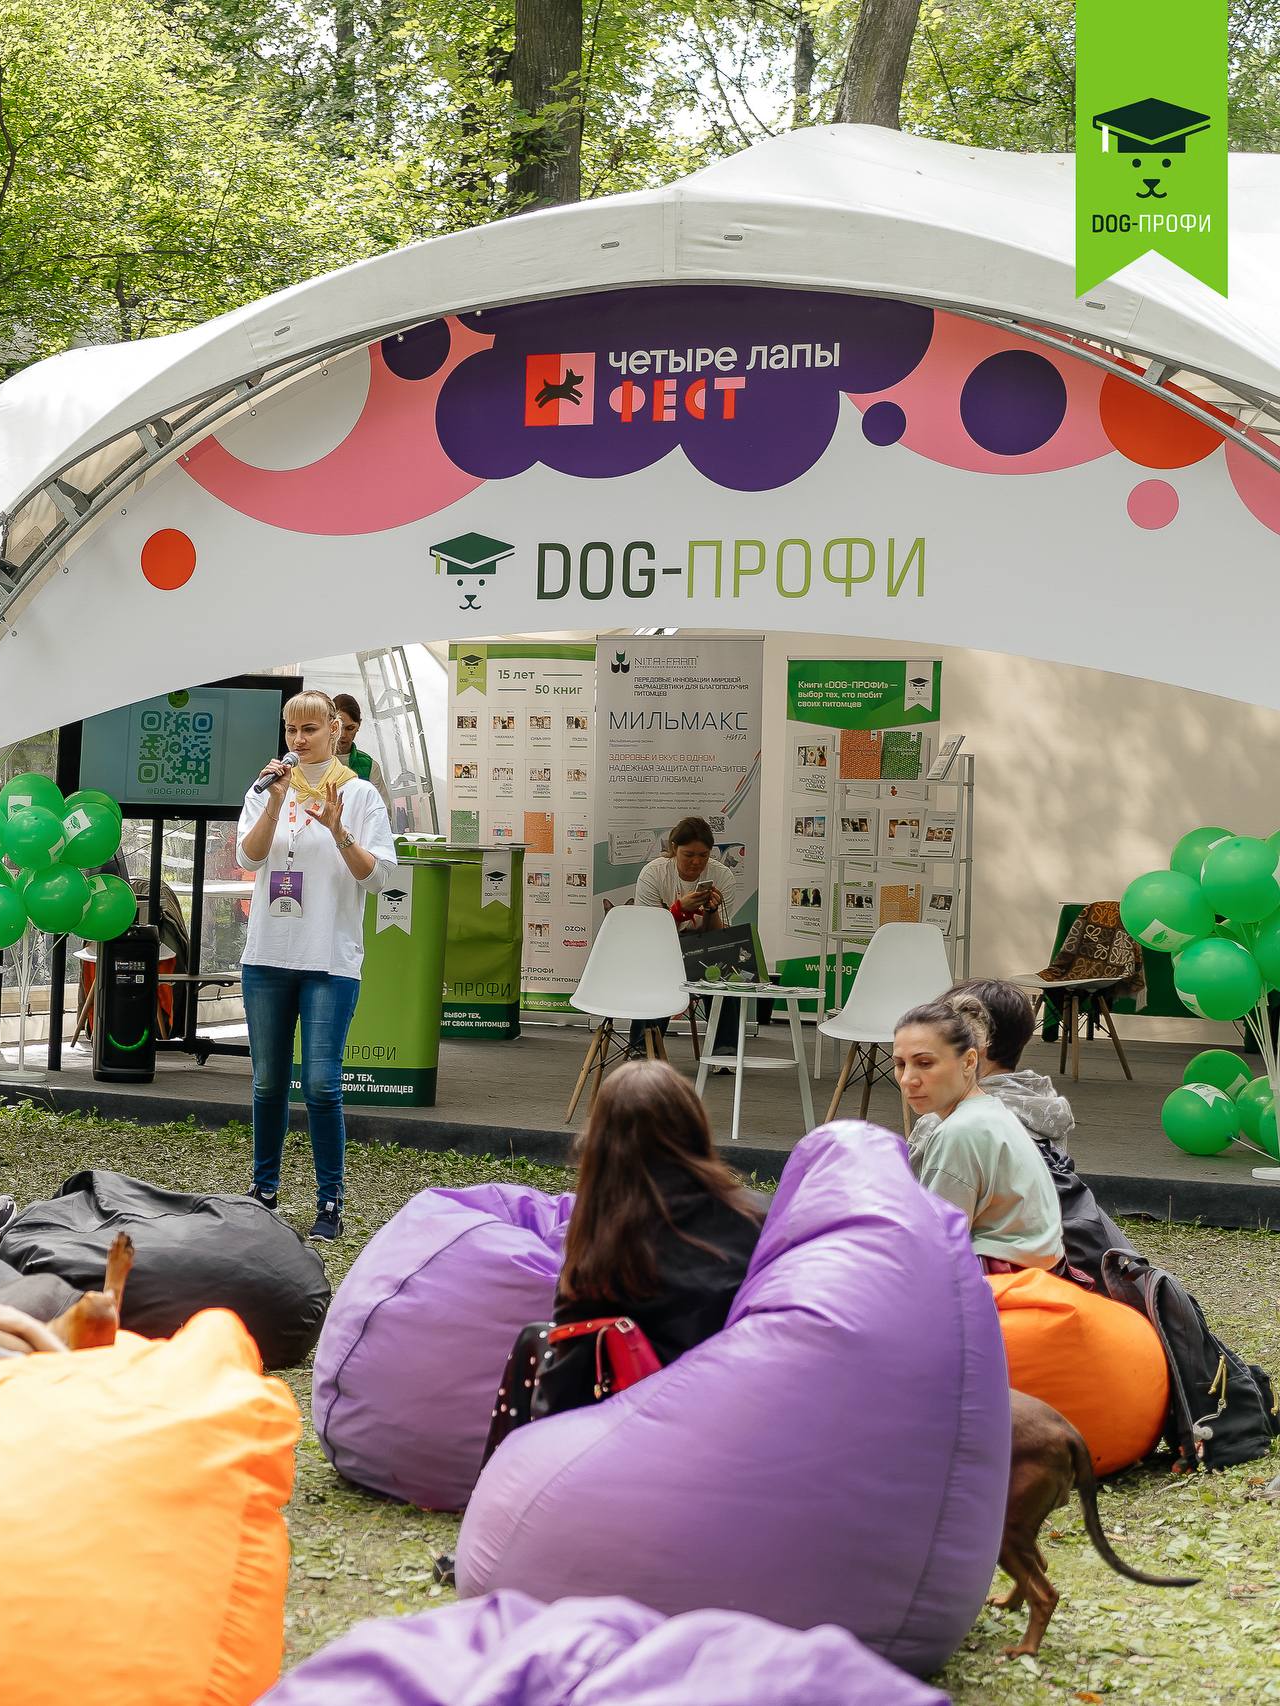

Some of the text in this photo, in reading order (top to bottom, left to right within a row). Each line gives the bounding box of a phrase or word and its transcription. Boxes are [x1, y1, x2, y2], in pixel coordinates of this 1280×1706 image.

[608, 342, 841, 375] четыре лапы
[608, 376, 746, 423] ФЕСТ
[536, 537, 926, 600] DOG-ПРОФИ
[498, 669, 536, 680] 15 лет
[535, 684, 583, 695] 50 книг
[798, 681, 823, 690] Книги
[824, 681, 888, 689] «DOG-ПРОФИ»
[798, 690, 824, 699] выбор
[857, 690, 883, 698] любит
[822, 701, 862, 709] питомцев
[609, 711, 748, 730] МИЛЬМАКС
[656, 765, 688, 773] ЗАЩИТА
[520, 966, 554, 974] G-ПРОФИ
[442, 982, 511, 997] G-ПРОФИ
[443, 1011, 467, 1019] ВЫБОР
[345, 1045, 397, 1060] ПРОФИ
[357, 1073, 375, 1083] ТЕХ,
[289, 1081, 301, 1089] ТО
[341, 1084, 414, 1095] ВОИХ ПИТОМЦЕВ
